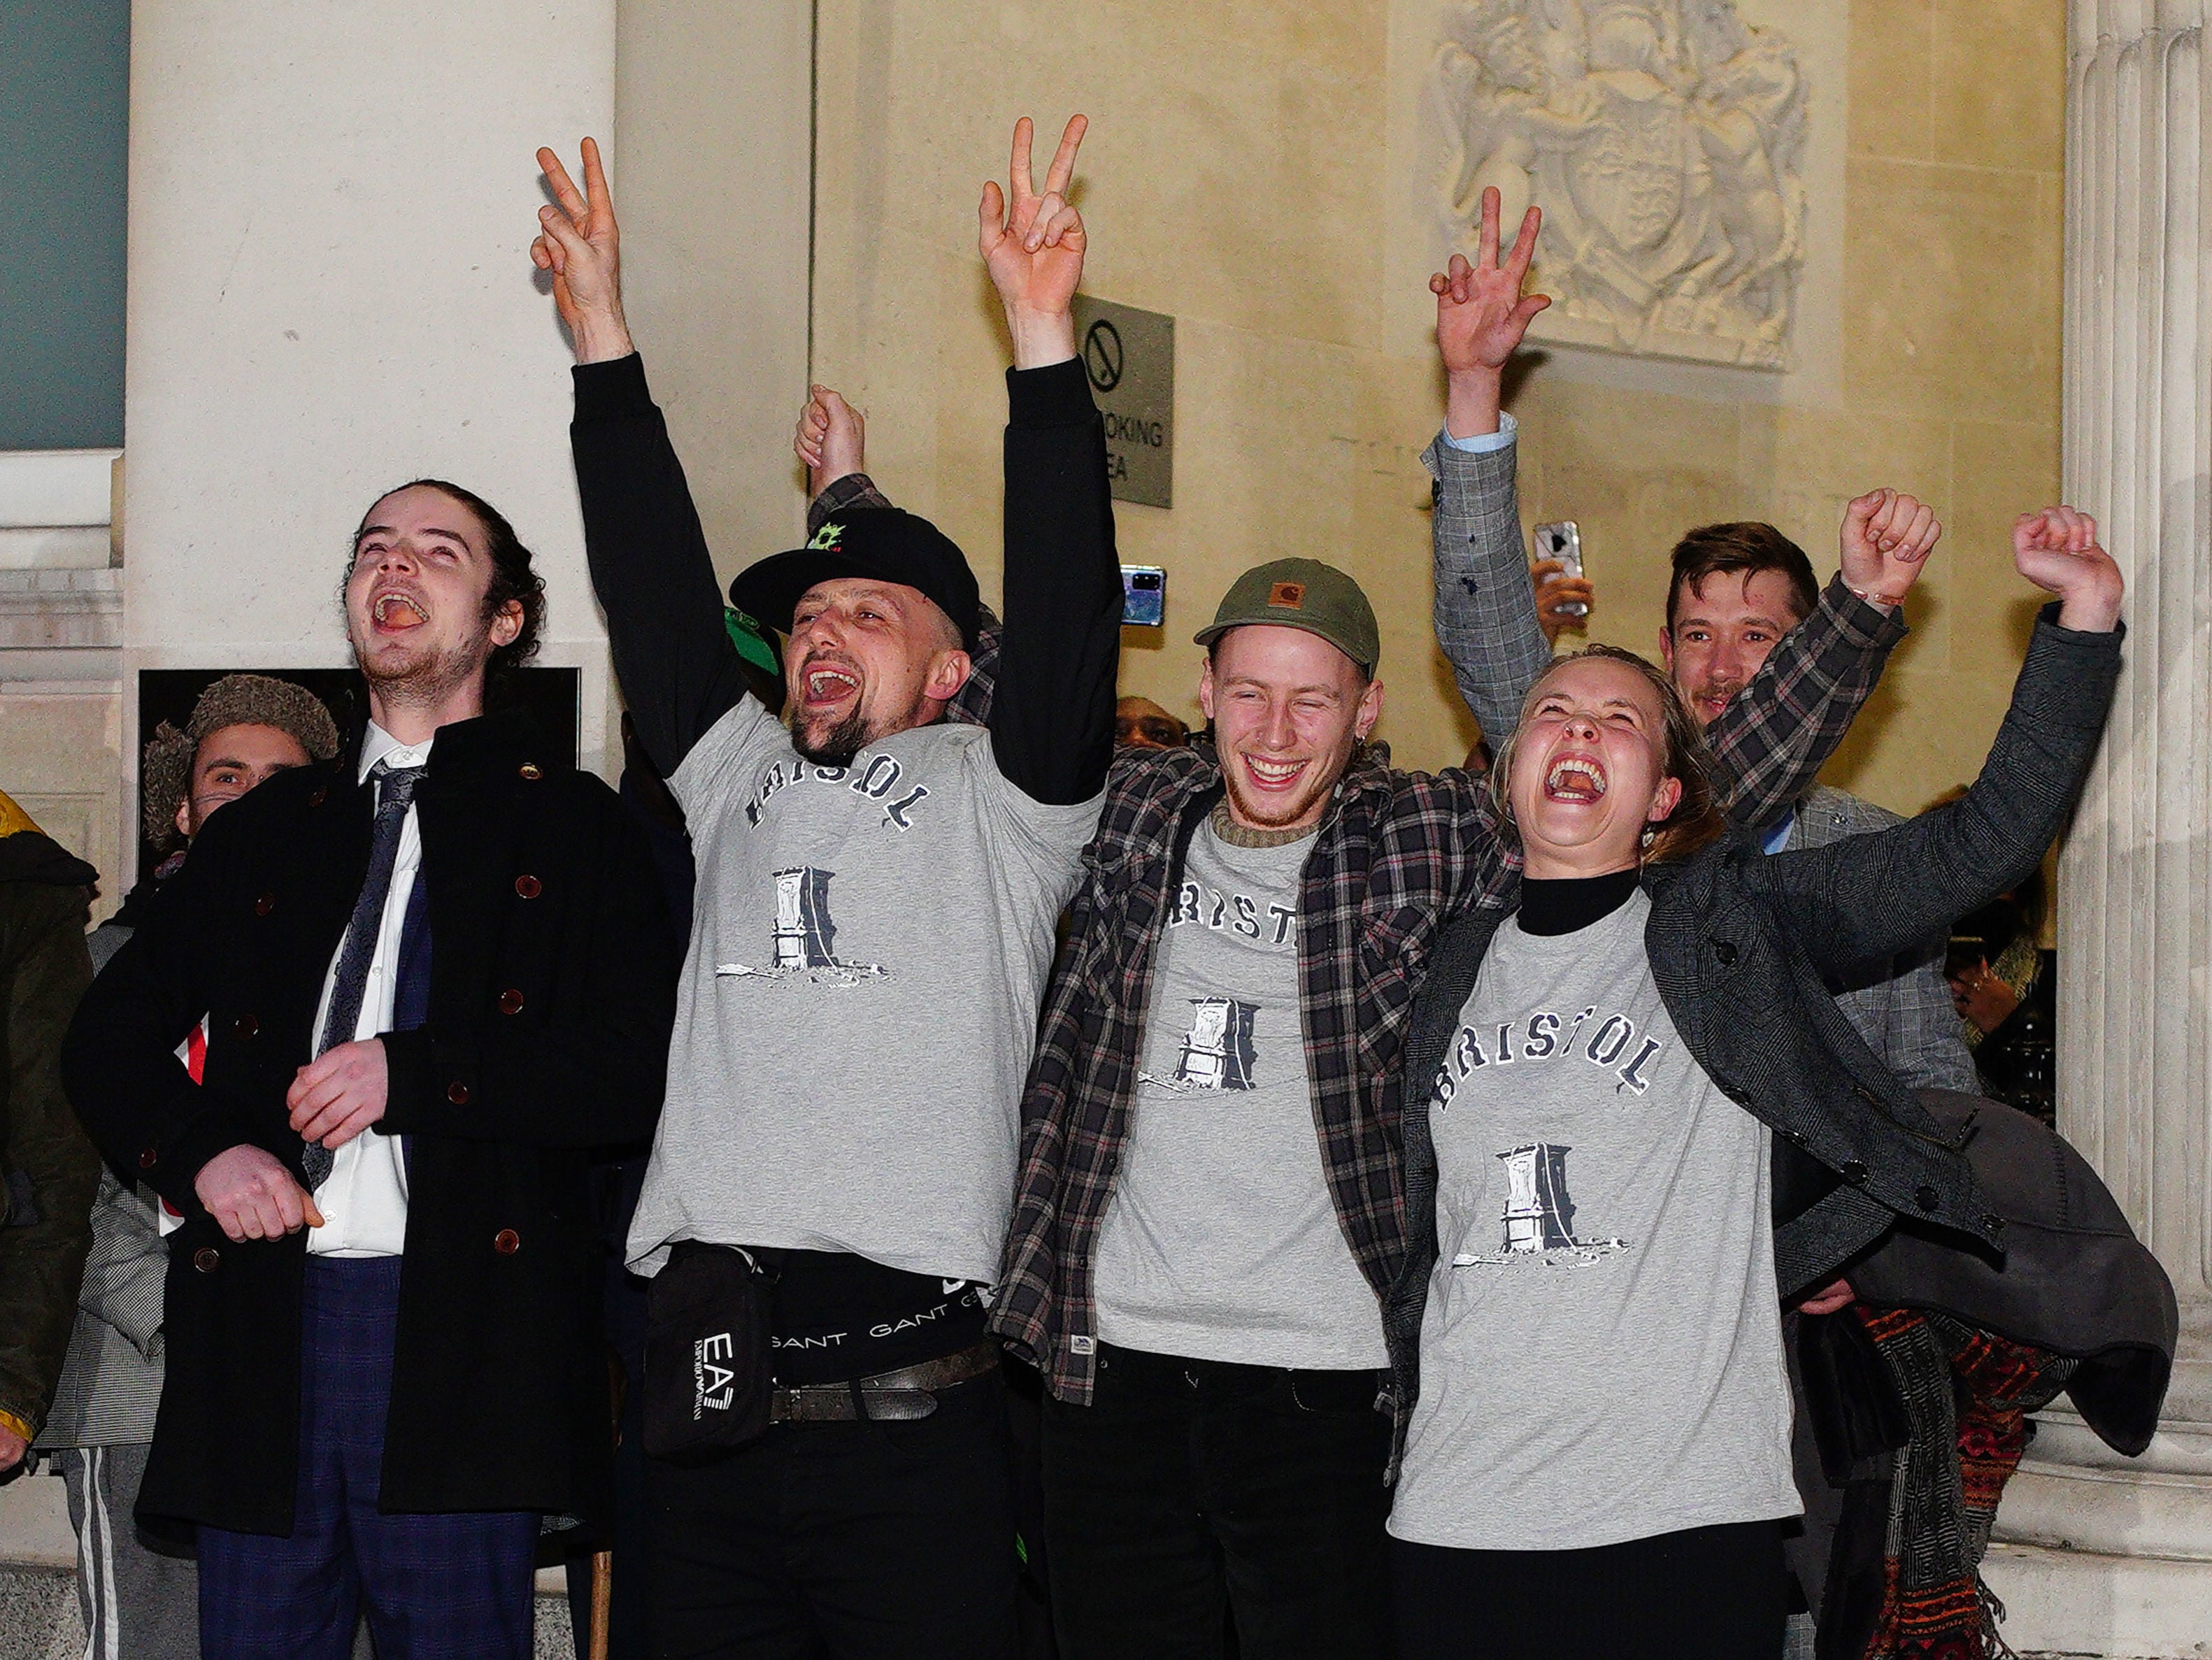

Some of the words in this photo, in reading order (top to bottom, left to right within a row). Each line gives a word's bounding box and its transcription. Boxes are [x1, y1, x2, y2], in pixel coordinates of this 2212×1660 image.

[745, 752, 932, 833] BRIOL
[1169, 880, 1299, 948] RIST
[869, 1303, 948, 1338] GANT
[704, 1332, 734, 1410] EA7
